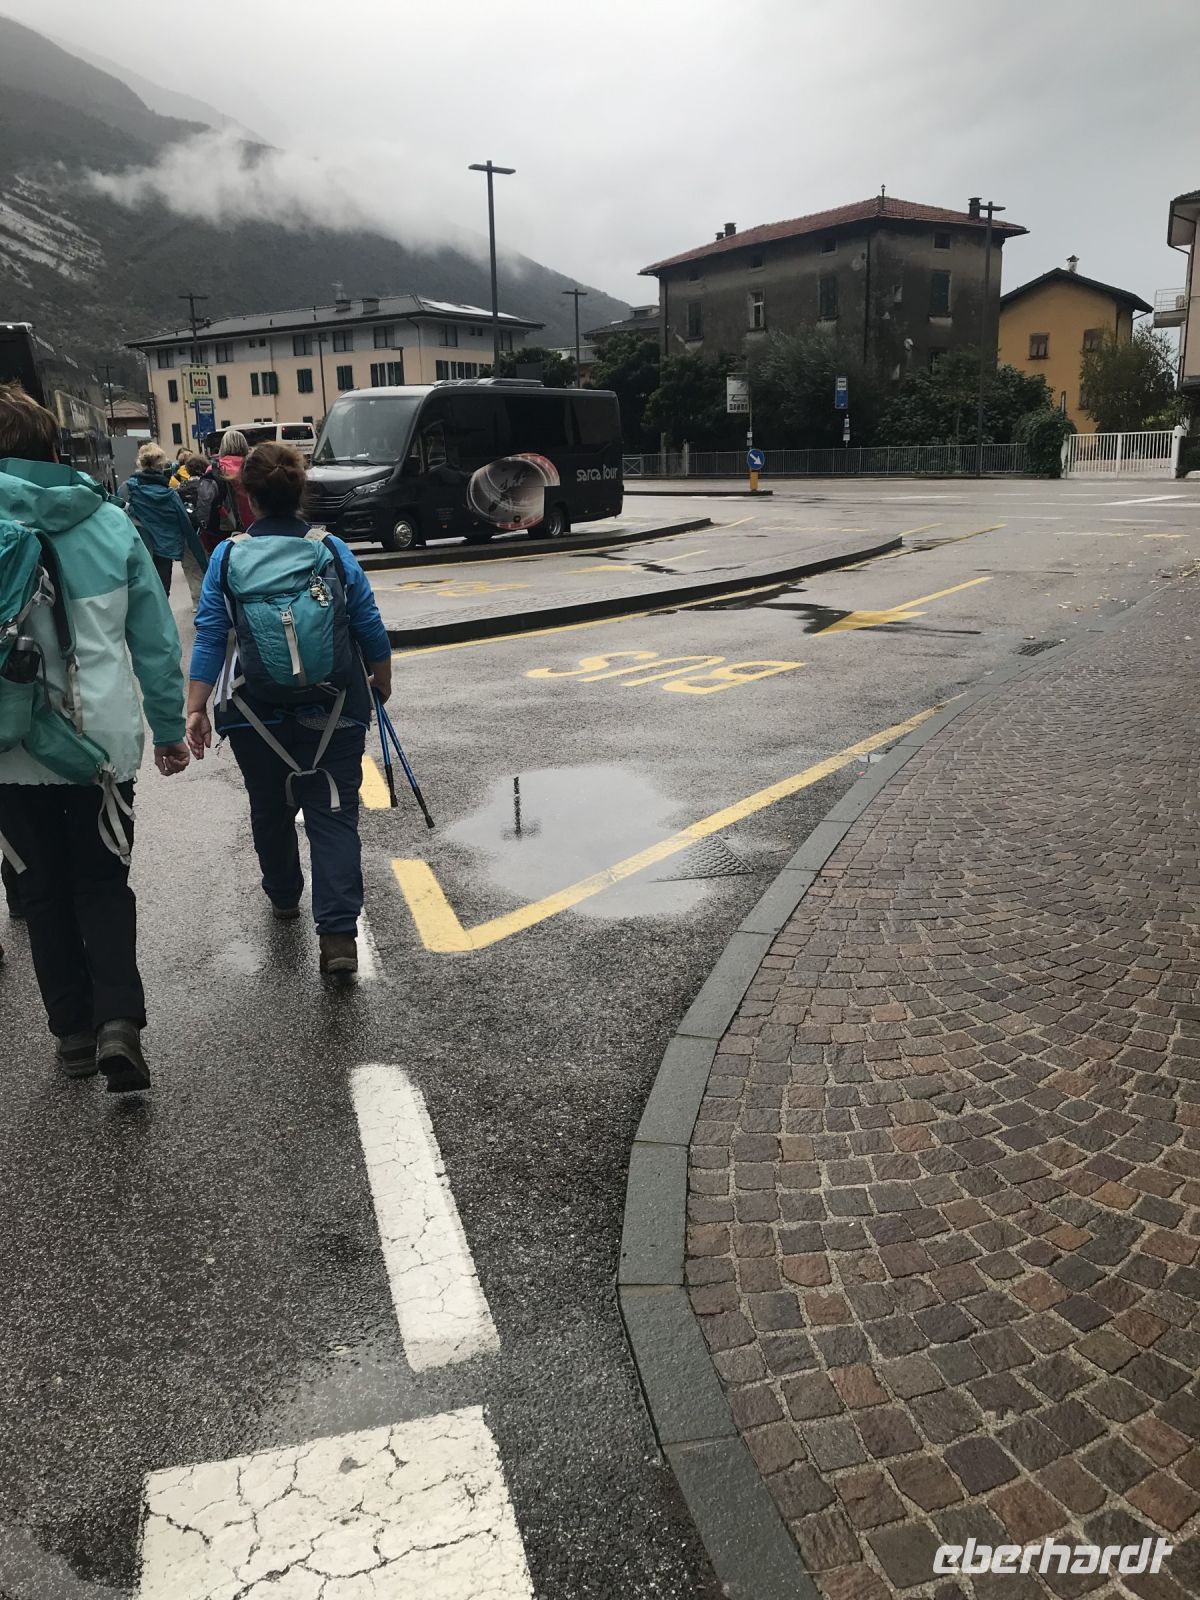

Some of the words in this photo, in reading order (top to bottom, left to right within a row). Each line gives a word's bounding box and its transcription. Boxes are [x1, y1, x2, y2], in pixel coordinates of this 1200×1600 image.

[193, 379, 207, 387] MD
[576, 469, 601, 481] sarca
[525, 650, 806, 695] BUS
